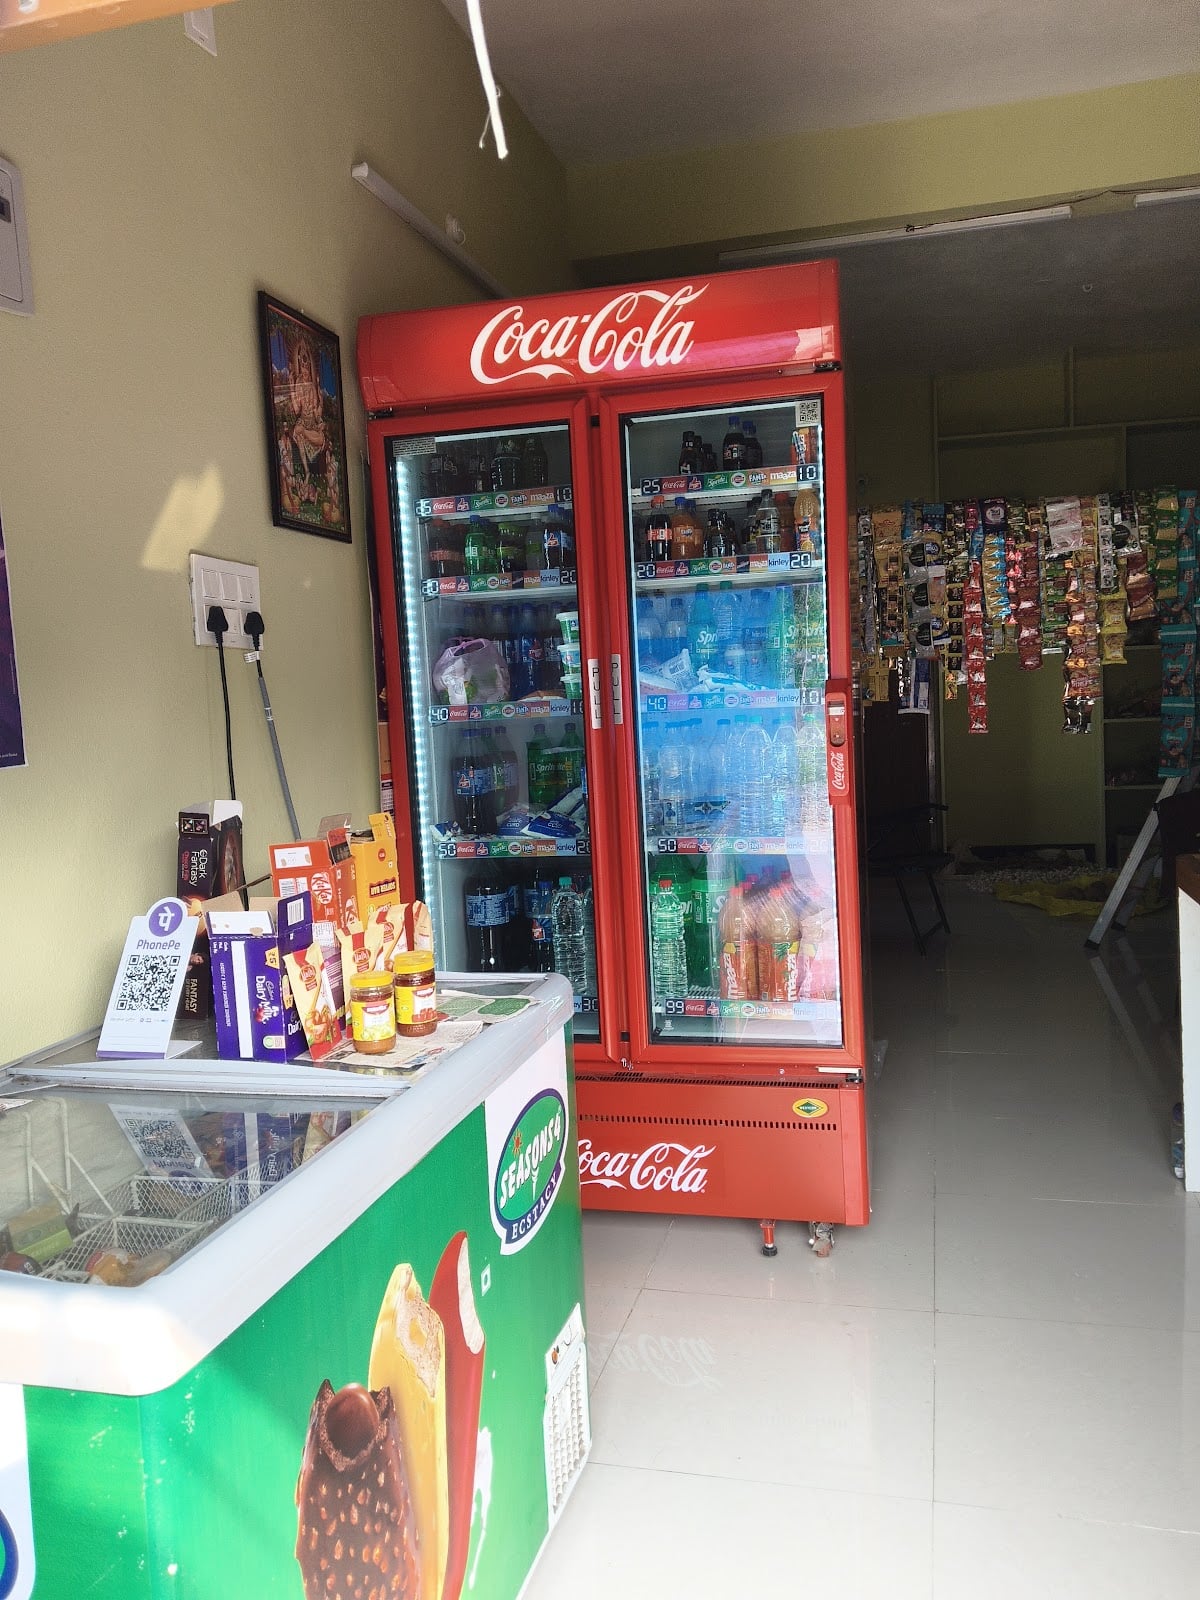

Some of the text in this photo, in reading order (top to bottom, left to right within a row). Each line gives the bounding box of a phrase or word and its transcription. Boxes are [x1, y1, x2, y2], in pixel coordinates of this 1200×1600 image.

[470, 283, 711, 385] Coca-Cola
[642, 479, 660, 494] 25
[770, 471, 797, 480] maaza
[799, 466, 817, 480] 10
[530, 492, 554, 503] maaza
[556, 487, 572, 501] 10
[540, 574, 559, 583] kinley
[560, 570, 577, 583] 20
[637, 564, 655, 578] 20
[768, 559, 789, 567] kinley
[790, 553, 811, 568] 20
[592, 667, 603, 719] PULL
[648, 697, 667, 711] 40
[777, 695, 800, 704] kinley
[802, 690, 820, 703] 10
[430, 708, 449, 720] 40
[551, 705, 570, 713] kinley
[830, 751, 846, 790] Coca-Cola
[439, 844, 456, 856] 50
[658, 839, 677, 852] 50
[189, 851, 201, 887] Fantasy
[198, 857, 208, 879] Dark
[312, 876, 332, 903] KitKat
[136, 939, 181, 951] PhonePe
[190, 978, 198, 1013] FANTASY
[255, 975, 268, 1001] Dairy
[666, 1000, 684, 1014] 99
[512, 1173, 558, 1240] ECSTACY
